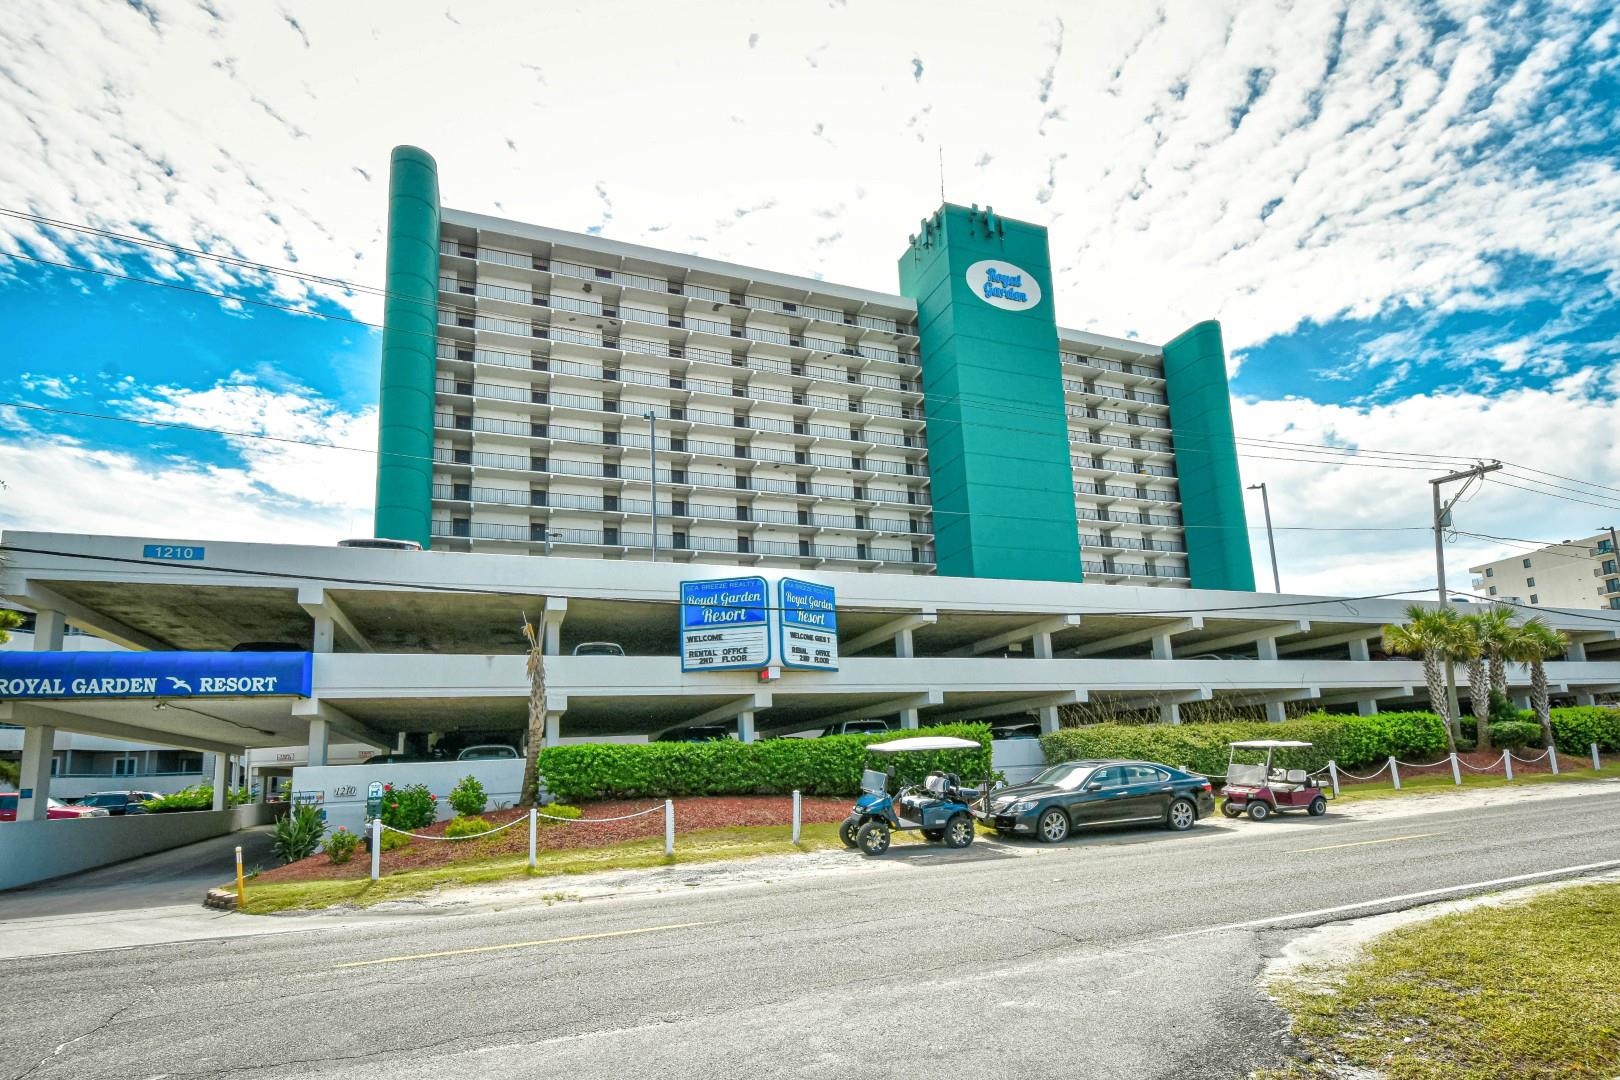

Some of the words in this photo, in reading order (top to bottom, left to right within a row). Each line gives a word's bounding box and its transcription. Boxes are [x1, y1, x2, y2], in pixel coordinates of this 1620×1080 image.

[986, 267, 1022, 288] Royal
[983, 281, 1028, 303] Garden
[155, 546, 193, 559] 1210
[729, 580, 755, 589] REALTY
[687, 593, 718, 608] Royal
[720, 592, 761, 606] Garden
[786, 592, 807, 607] Royal
[808, 595, 833, 610] Garden
[702, 608, 747, 623] Resort
[797, 609, 825, 625] Resort
[687, 633, 723, 643] WELCOME
[790, 631, 814, 641] WELCOME
[688, 649, 718, 659] RENTAL
[722, 647, 748, 656] OFFICE
[699, 657, 714, 665] 2ND
[722, 654, 747, 663] FLOOR
[814, 656, 830, 664] FLOOR
[71, 678, 157, 694] GARDEN
[199, 676, 278, 693] RESORT
[335, 783, 357, 797] 1210
